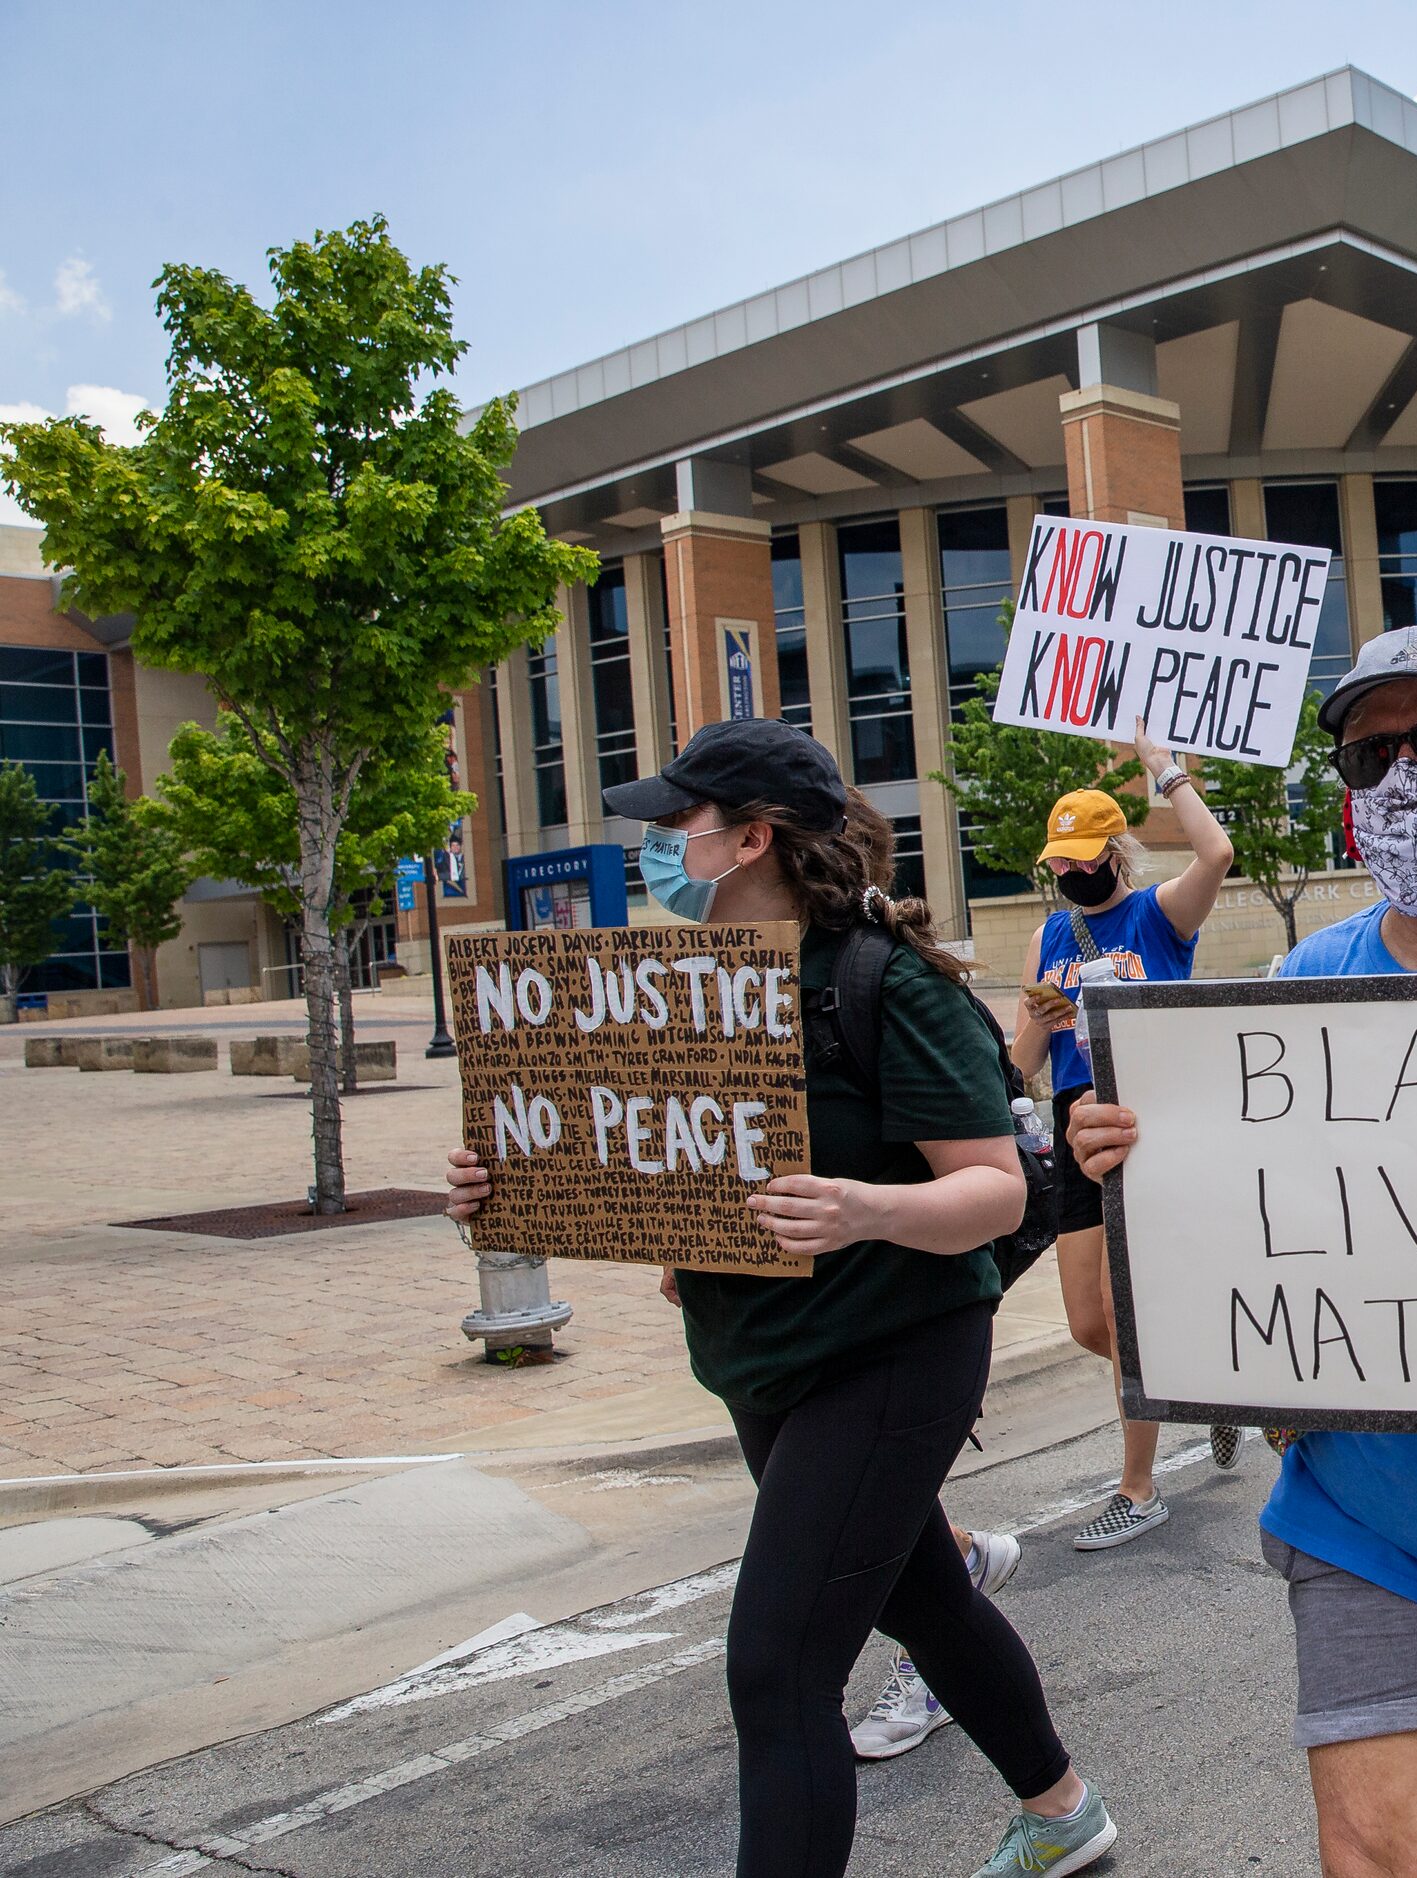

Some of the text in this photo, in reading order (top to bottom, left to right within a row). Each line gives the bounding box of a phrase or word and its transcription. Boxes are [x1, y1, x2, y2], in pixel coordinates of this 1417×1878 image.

[1020, 525, 1327, 649] KNOW JUSTICE
[1019, 630, 1279, 756] KNOW PEACE
[650, 841, 680, 857] MATTER
[524, 860, 587, 878] IRECTORY
[449, 927, 757, 958] ALBERT JOSEPH DAVIS DARRIUS STEWART
[449, 959, 474, 981] BILLY
[476, 962, 553, 1034] NO
[575, 955, 793, 1039] JUSTICE
[458, 1032, 520, 1057] PATERSON
[526, 1031, 579, 1049] BROWN
[588, 1028, 640, 1051] DOMINIC
[463, 1048, 800, 1069] ASHFORD ALONZO SMITH TYREE CRAWFORD INDIA KAGER
[529, 1070, 567, 1085] BIGGS
[575, 1067, 626, 1087] MICHAEL
[628, 1071, 648, 1086] LEE
[651, 1067, 713, 1087] MARSHALL
[719, 1067, 760, 1088] JAMAR
[466, 1105, 486, 1123] LEE
[493, 1083, 771, 1182] NO PEACE
[767, 1131, 804, 1148] KEITH
[509, 1158, 566, 1174] WENDELL
[604, 1170, 651, 1186] PERKINS
[656, 1172, 725, 1188] CHRISTOPHER
[537, 1187, 578, 1201] GAINES
[584, 1187, 619, 1199] TORREY
[621, 1187, 675, 1200] ROBINSON
[681, 1189, 716, 1203] DARIUS
[541, 1203, 594, 1219] TRUXILLO
[603, 1201, 660, 1215] DEMARCUS
[663, 1202, 701, 1218] SEMER
[709, 1205, 746, 1220] WILLIE
[472, 1217, 519, 1231] TERRILL
[523, 1218, 566, 1233] THOMAS
[575, 1217, 623, 1232] SYLVILLE
[671, 1218, 705, 1232] ALTON
[707, 1218, 766, 1237] STERLING
[520, 1231, 574, 1246] TERENCE
[576, 1230, 636, 1246] CRUTCHER
[641, 1232, 664, 1247] PAUL
[668, 1232, 709, 1248] O'NEAL
[715, 1235, 757, 1250] ALTERIA
[553, 1247, 583, 1258] AARON
[584, 1246, 615, 1260] BAILEY
[621, 1247, 655, 1262] RONELL
[658, 1247, 691, 1263] FOSTER
